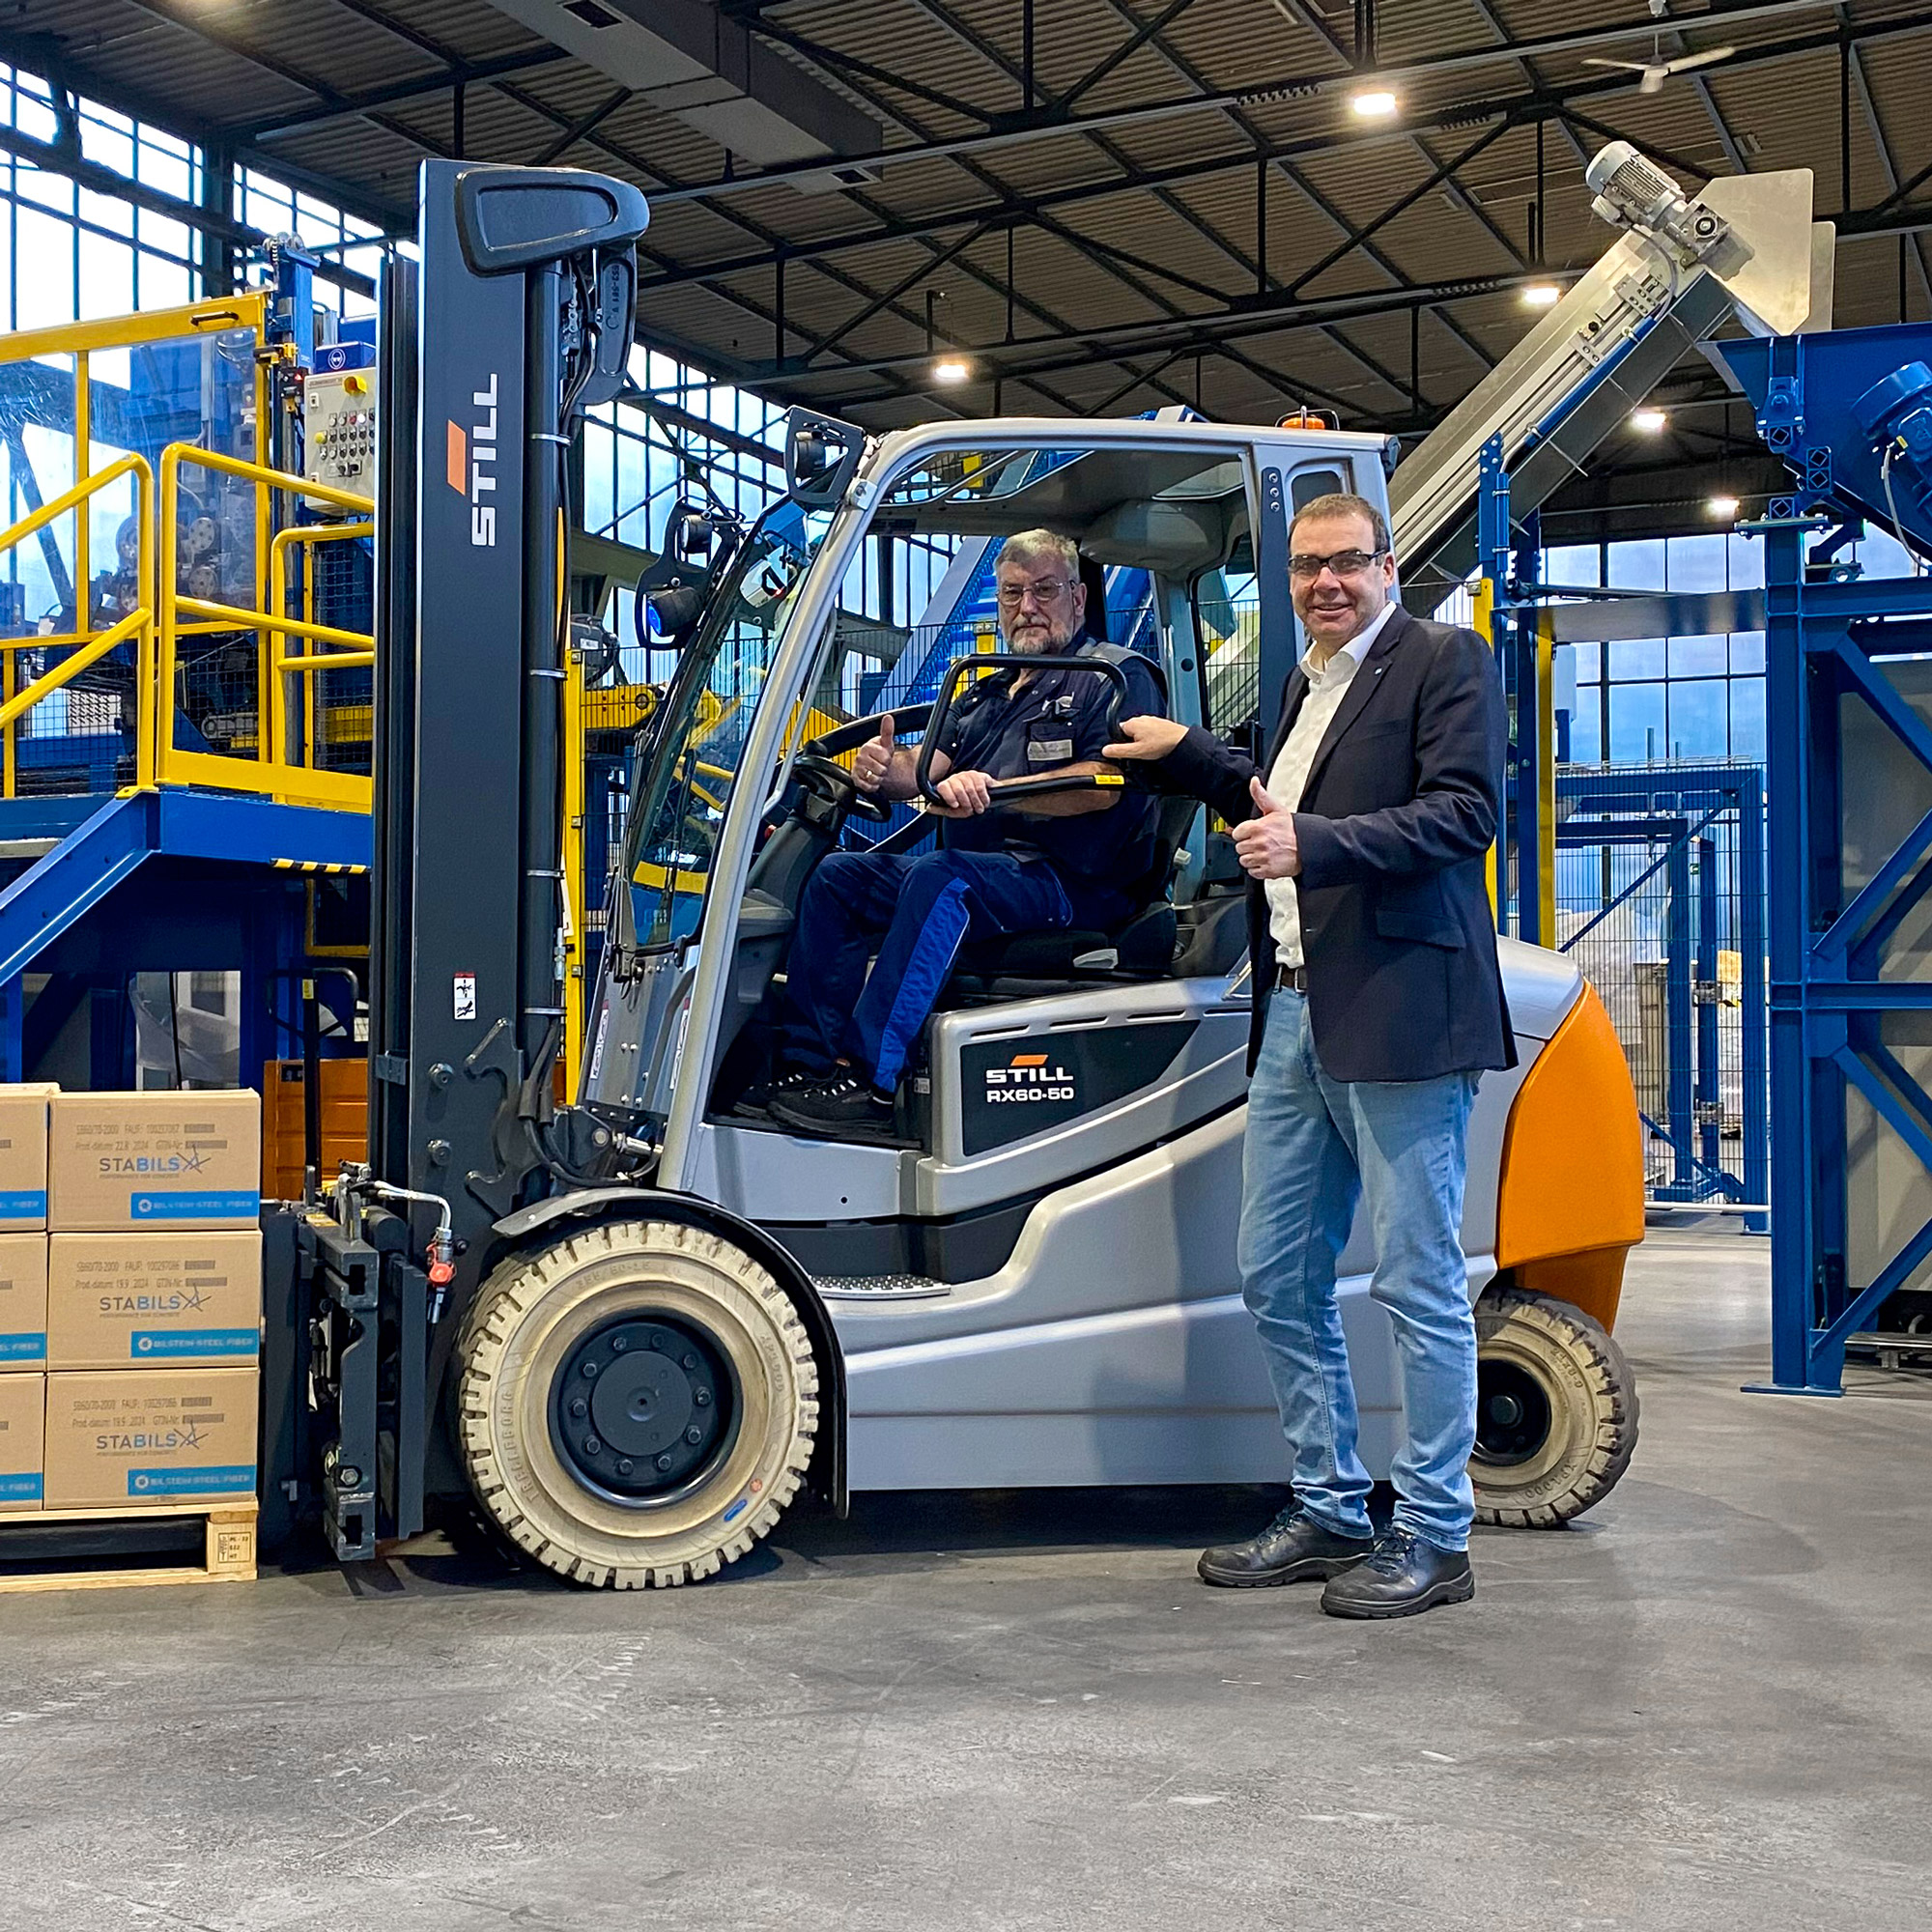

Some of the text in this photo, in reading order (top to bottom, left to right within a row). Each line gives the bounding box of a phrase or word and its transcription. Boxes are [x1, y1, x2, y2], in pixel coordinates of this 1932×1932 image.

[471, 373, 497, 547] STILL
[986, 1066, 1074, 1084] STILL
[986, 1087, 1075, 1103] RX60-50
[501, 1391, 540, 1503] TRELLEBORG
